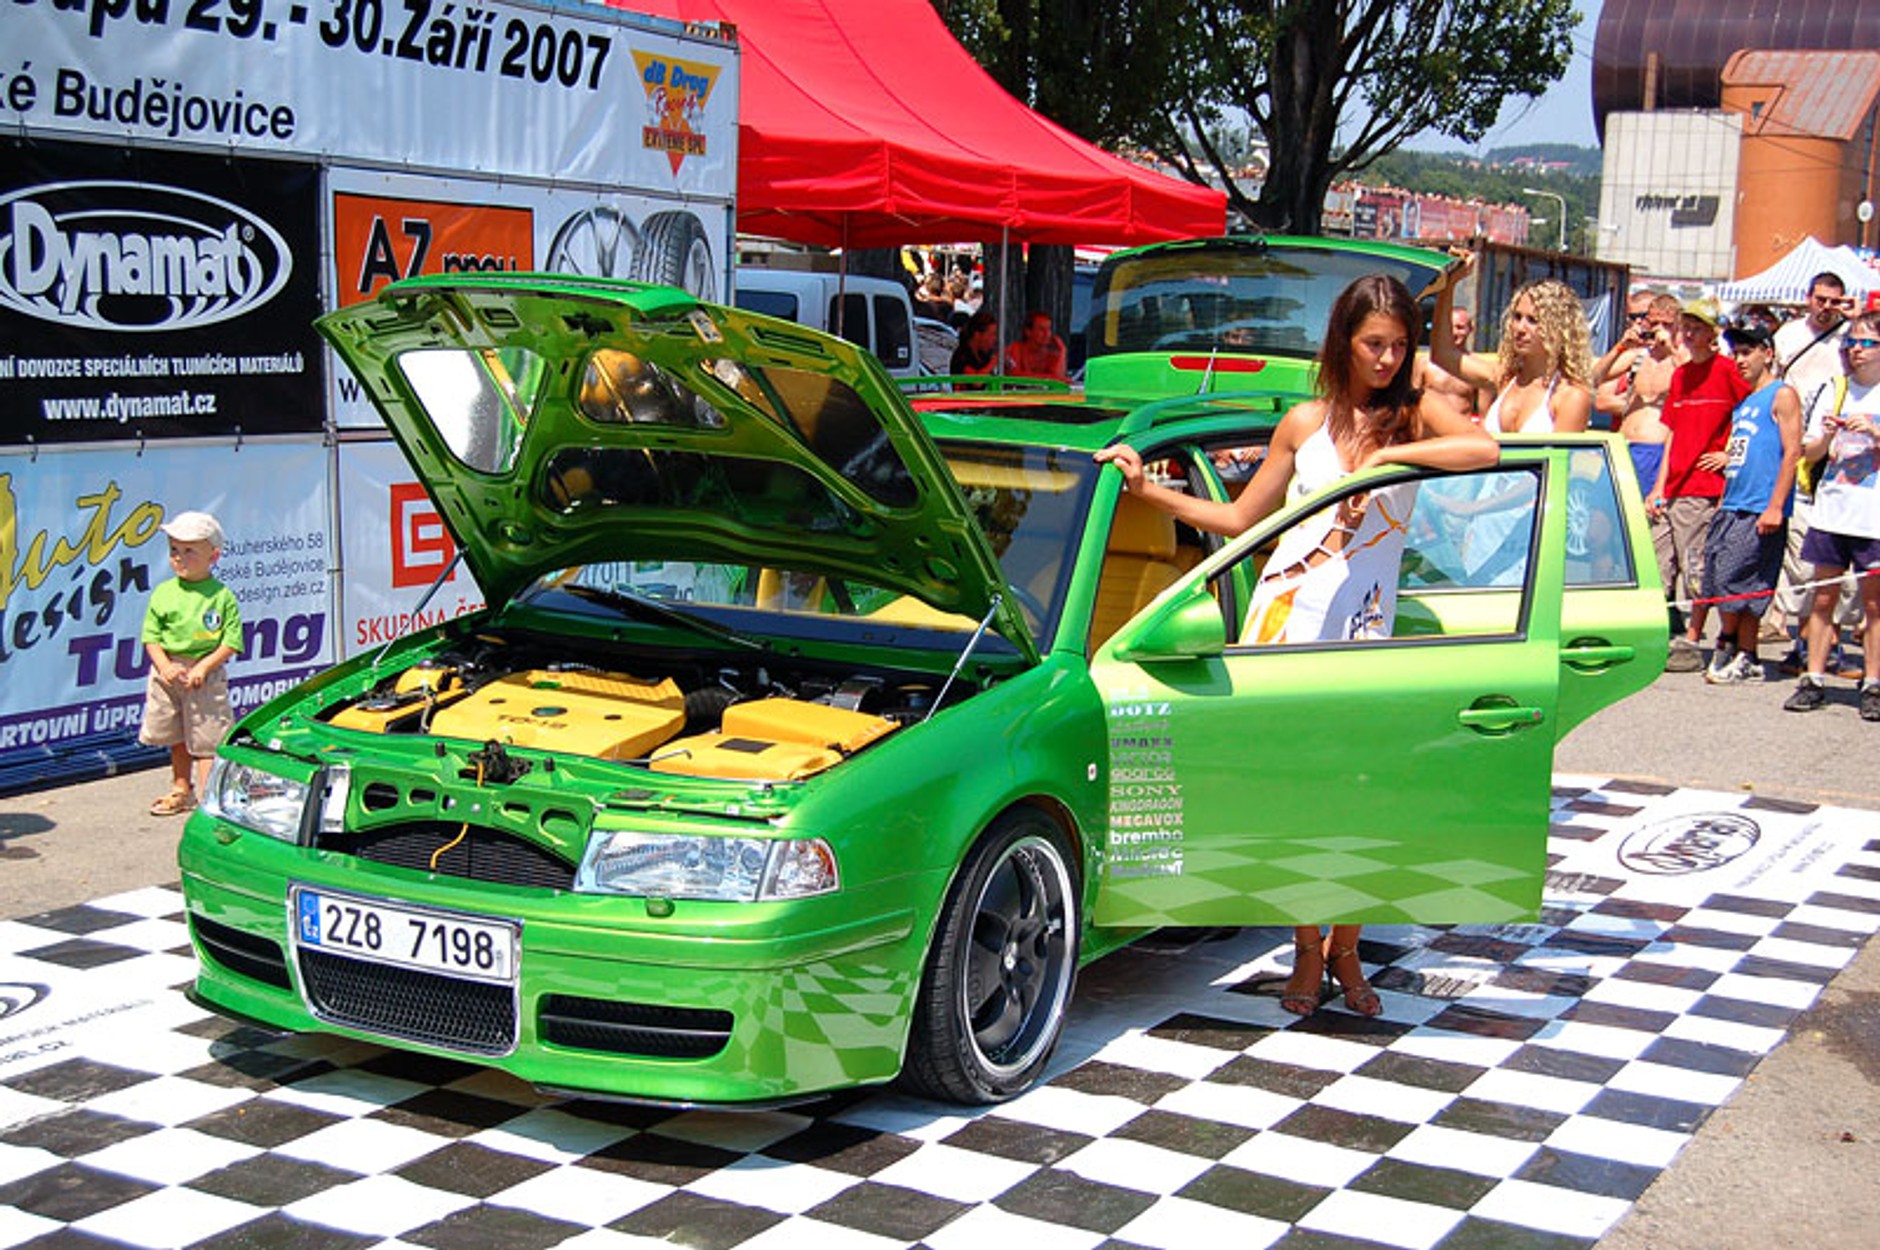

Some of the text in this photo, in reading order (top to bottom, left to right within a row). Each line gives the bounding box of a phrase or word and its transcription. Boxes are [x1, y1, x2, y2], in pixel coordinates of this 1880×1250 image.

[500, 19, 611, 90] 2007
[54, 68, 294, 139] Budějovice
[18, 358, 81, 378] DOVOZCE
[84, 354, 170, 377] SPECIÁLNÍCH
[172, 352, 237, 376] TLUMÍCÍCH
[43, 391, 217, 423] www.dynamat.cz
[306, 531, 324, 549] 58
[254, 559, 324, 578] Budějovice
[1109, 785, 1183, 797] SONY
[1109, 812, 1184, 828] MEGAVOX
[1109, 829, 1184, 844] brembo
[326, 904, 494, 970] 2Z8 7198
